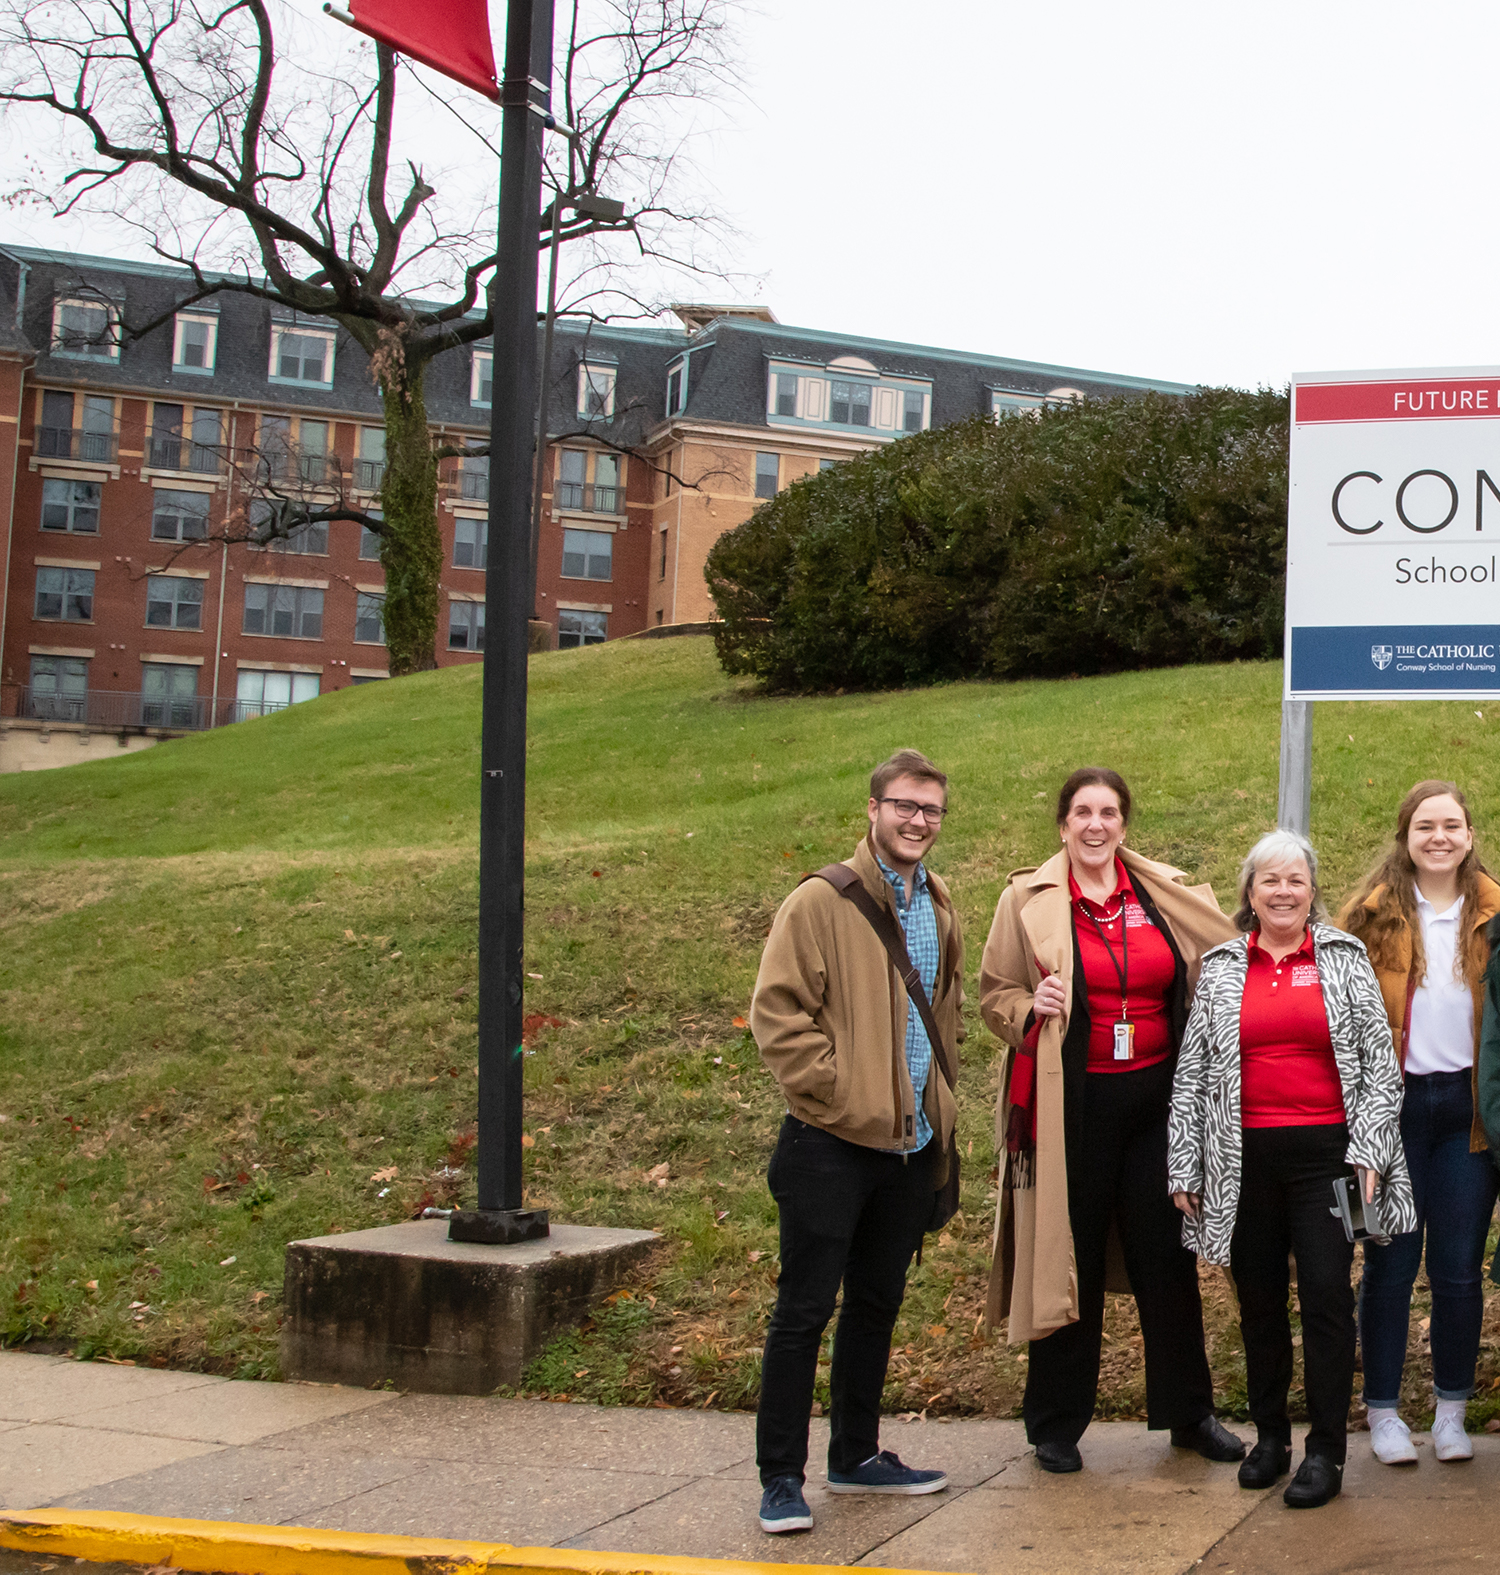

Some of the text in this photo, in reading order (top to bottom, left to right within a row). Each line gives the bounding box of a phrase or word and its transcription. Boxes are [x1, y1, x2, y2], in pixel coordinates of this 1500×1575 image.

[1394, 390, 1489, 411] FUTURE
[1395, 555, 1496, 584] School
[1396, 645, 1415, 654] THE
[1416, 644, 1495, 658] CATHOLIC
[1396, 662, 1496, 673] Conway School of Nursing
